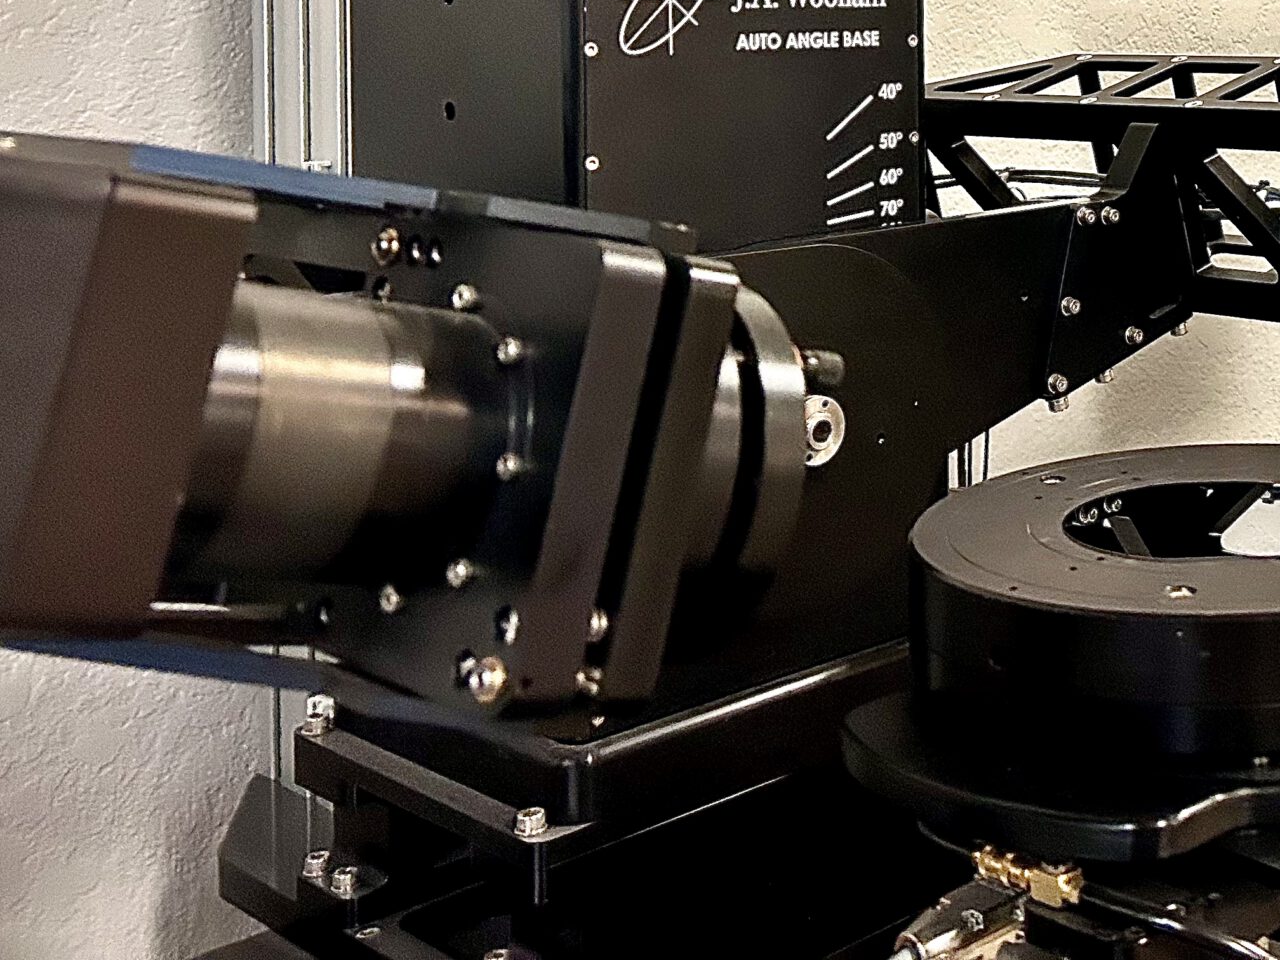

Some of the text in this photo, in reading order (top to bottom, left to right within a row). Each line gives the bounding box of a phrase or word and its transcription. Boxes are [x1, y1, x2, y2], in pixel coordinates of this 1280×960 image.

[736, 30, 881, 52] AUTO ANGLE BASE
[878, 82, 903, 100] 40°
[879, 131, 904, 150] 50°
[879, 167, 904, 186] 60°
[879, 198, 905, 217] 70°
